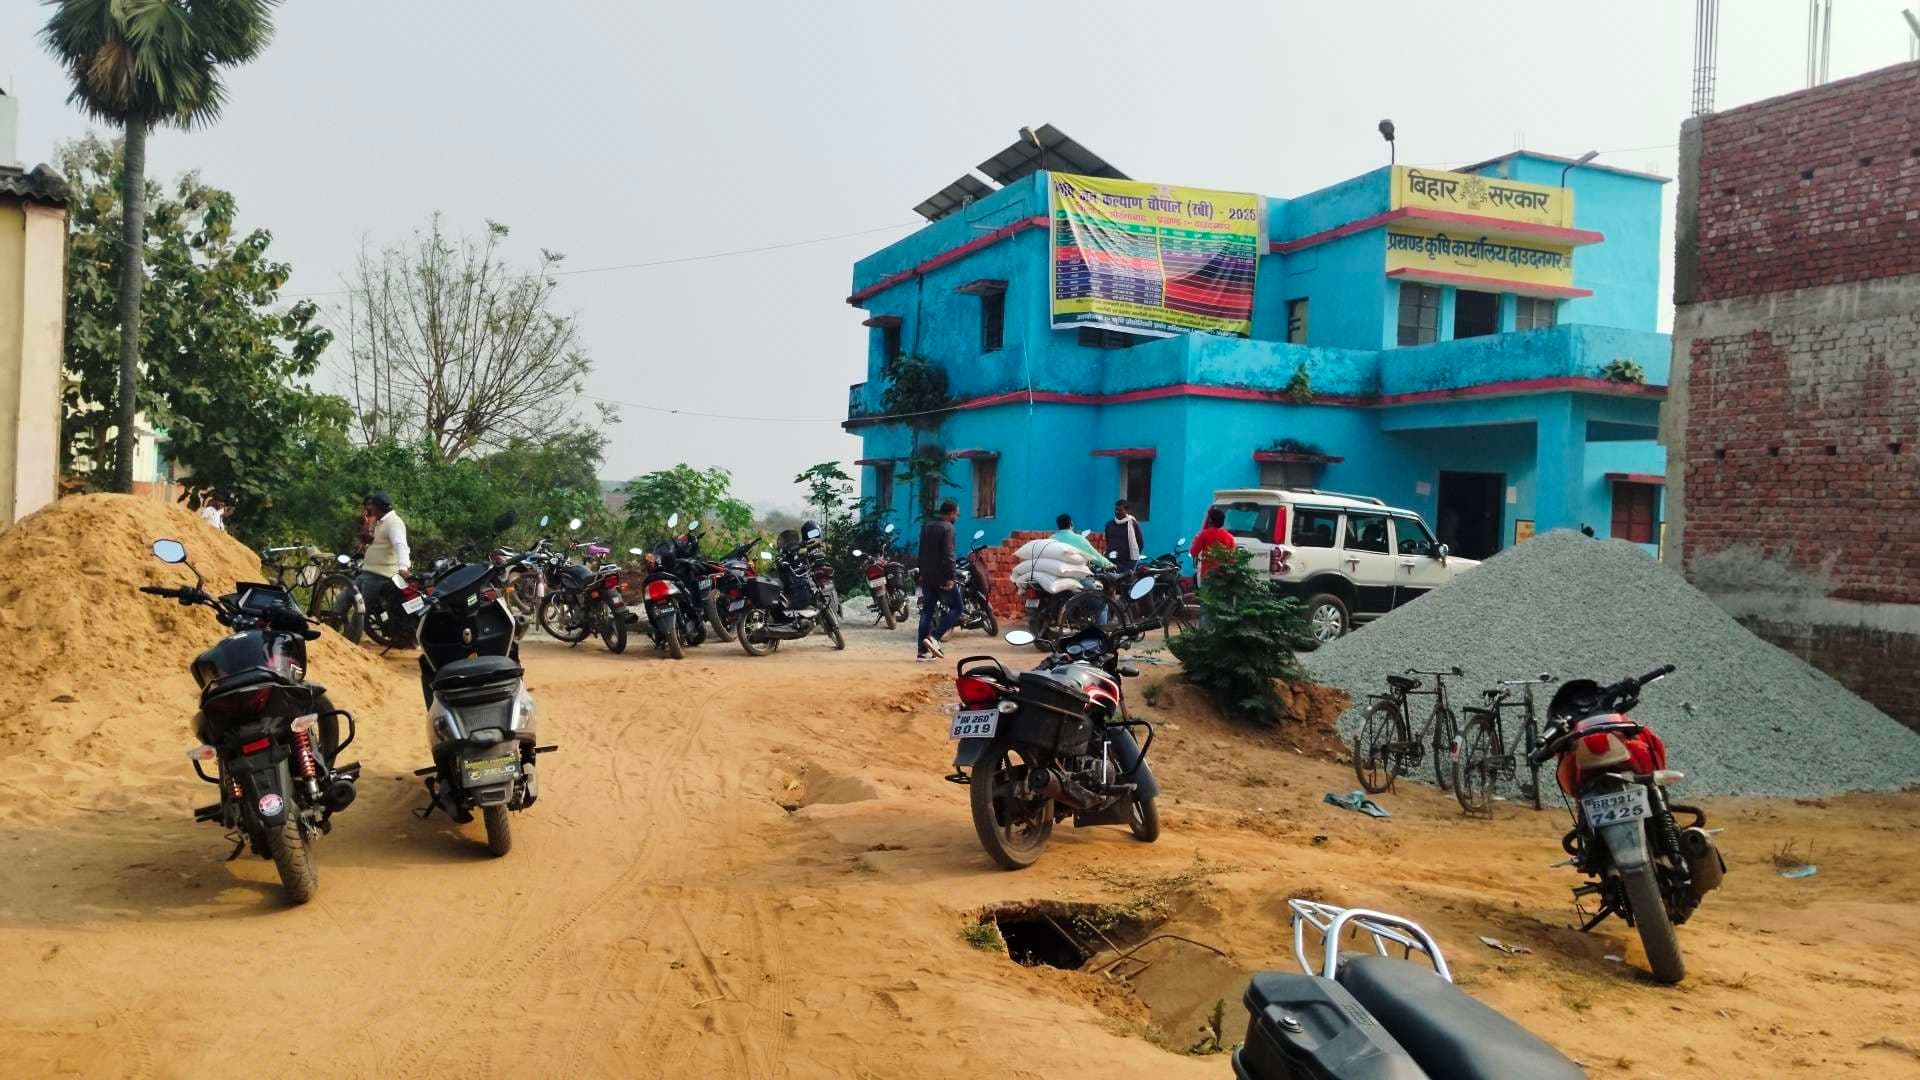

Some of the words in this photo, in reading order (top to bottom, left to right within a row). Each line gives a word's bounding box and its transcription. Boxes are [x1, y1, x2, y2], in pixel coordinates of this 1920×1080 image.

[1103, 193, 1142, 210] कल्याण
[1408, 169, 1459, 202] बिहार
[1488, 185, 1549, 213] सरकार
[1387, 232, 1424, 253] प्रखण्ड
[1424, 233, 1451, 260] कृषि
[1451, 235, 1507, 263] कार्यालय
[953, 723, 991, 736] 8019
[1591, 804, 1644, 825] 7425
